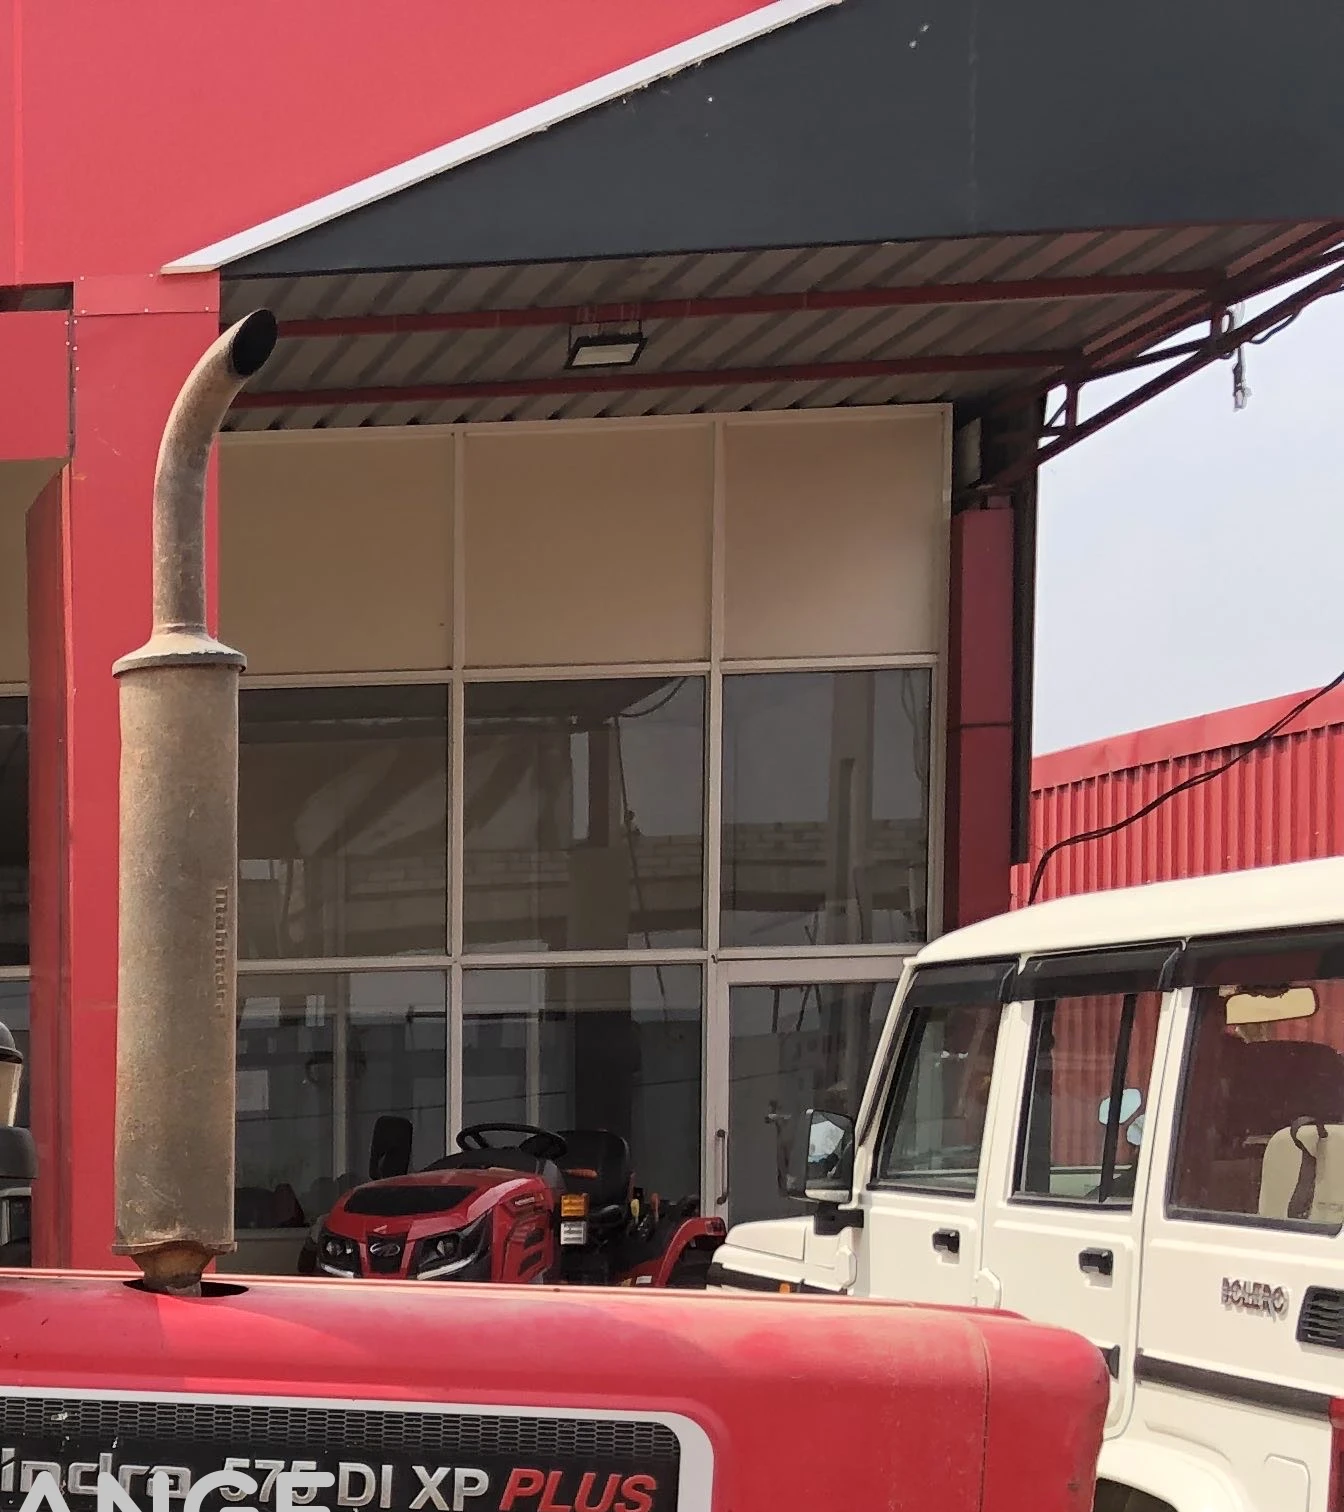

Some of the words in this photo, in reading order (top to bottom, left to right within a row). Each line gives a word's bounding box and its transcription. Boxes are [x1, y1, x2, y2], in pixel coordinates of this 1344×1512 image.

[1221, 1277, 1289, 1321] BOLERO
[337, 1463, 394, 1509] DI
[409, 1465, 490, 1512] XP
